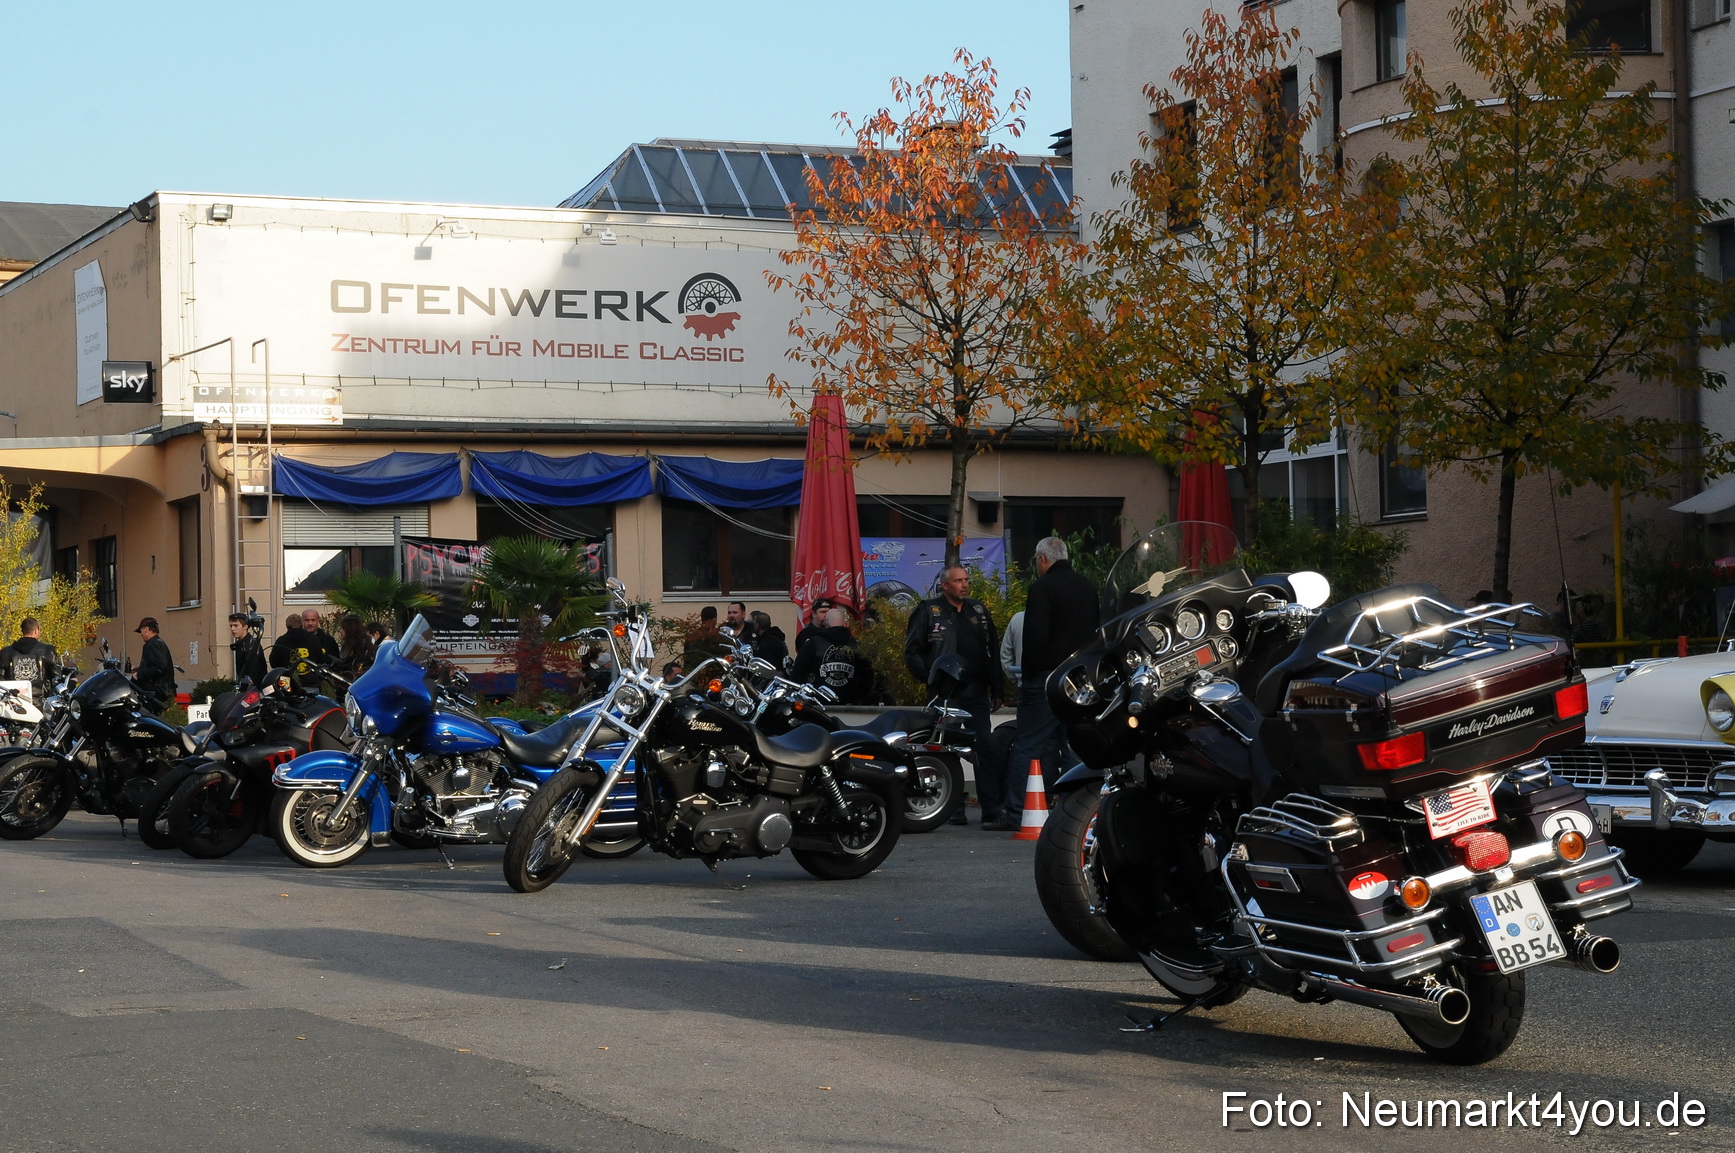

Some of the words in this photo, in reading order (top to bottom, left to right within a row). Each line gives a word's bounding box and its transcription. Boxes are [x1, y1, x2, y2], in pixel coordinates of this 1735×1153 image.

[331, 279, 673, 324] OFENWERK
[331, 333, 461, 355] ZENTRUM
[472, 335, 522, 357] FÜR
[532, 339, 629, 360] MOBILE
[639, 342, 745, 363] CLASSIC
[109, 370, 147, 393] sky
[196, 710, 209, 719] Par
[1449, 705, 1535, 740] Harley-Davidson
[1477, 812, 1489, 820] RIDE
[1492, 889, 1523, 916] AN
[1485, 918, 1494, 928] D
[1496, 943, 1530, 969] BB
[1528, 933, 1560, 960] 54
